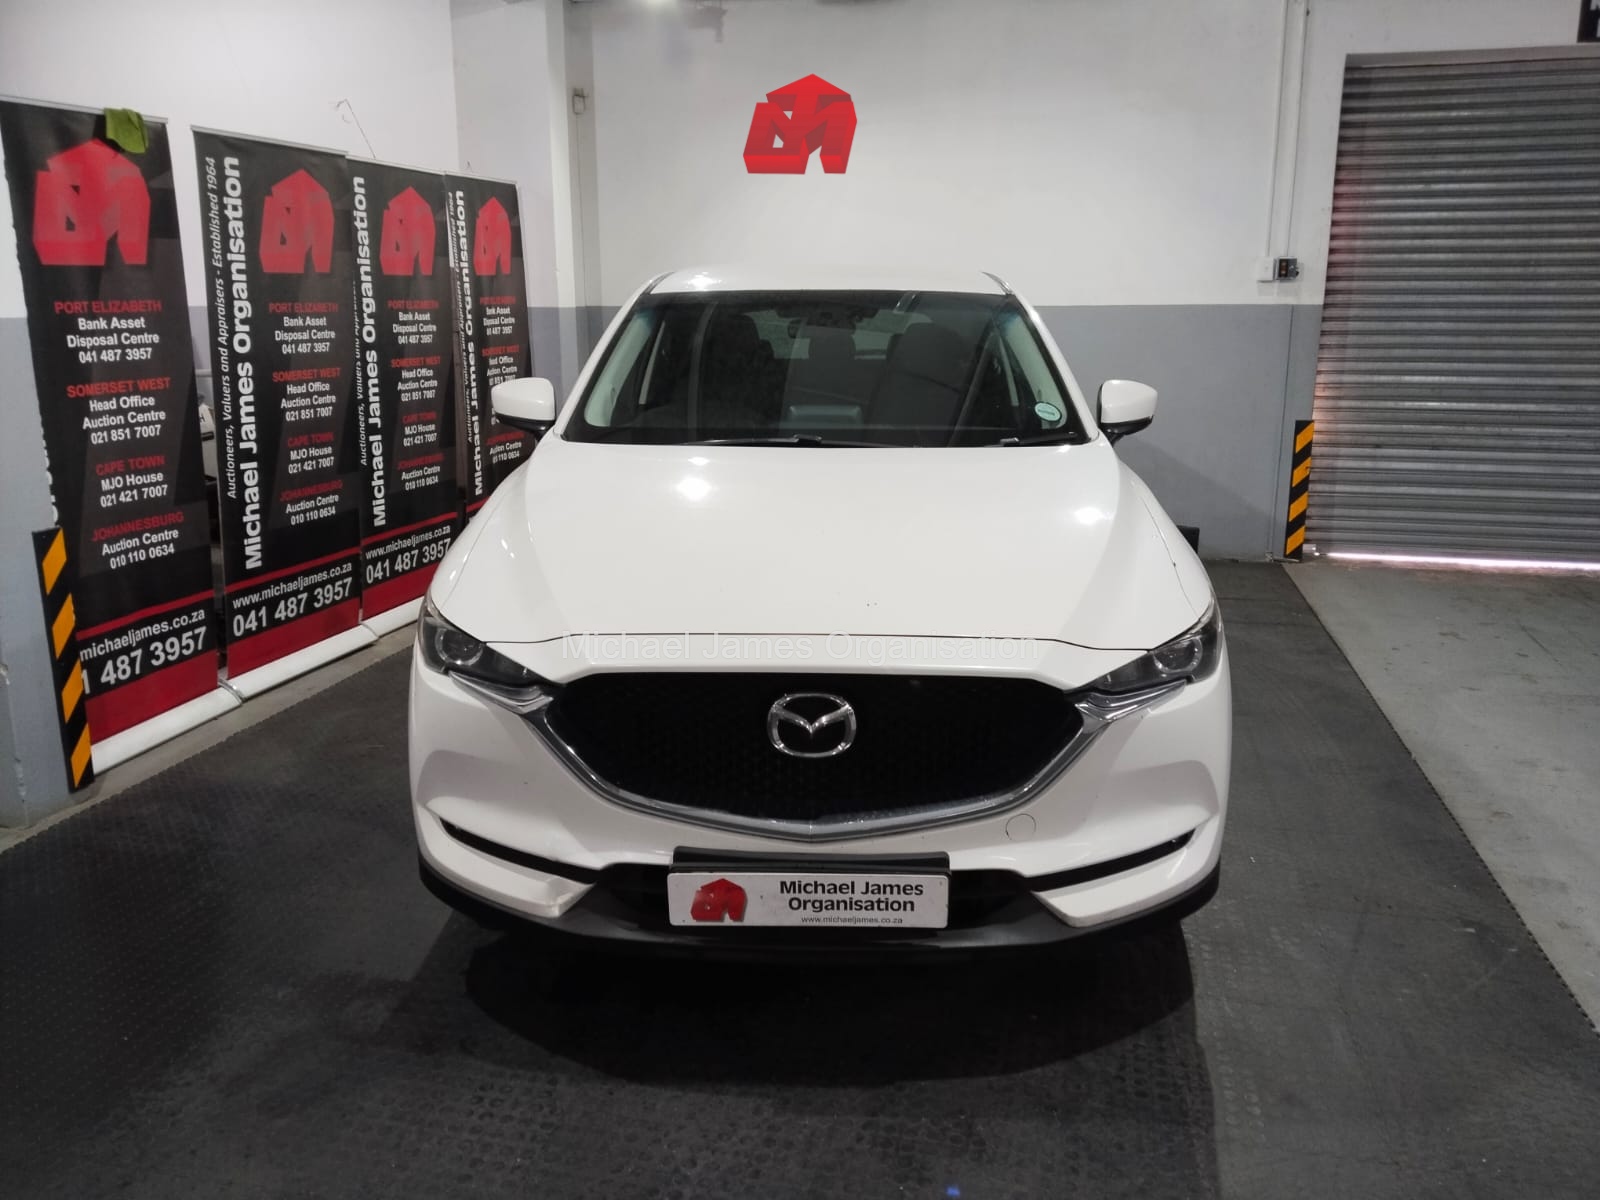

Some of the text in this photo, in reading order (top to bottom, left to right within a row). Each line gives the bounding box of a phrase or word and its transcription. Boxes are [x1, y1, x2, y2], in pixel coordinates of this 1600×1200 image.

[205, 156, 217, 190] 1964
[207, 193, 223, 268] Established
[353, 176, 376, 343] Organisation
[54, 300, 162, 314] PORT ELIZABETH
[212, 277, 228, 345] Appraisers
[78, 317, 146, 331] Bank Asset
[283, 316, 327, 327] Bank Asset
[66, 332, 160, 349] Disposal Centre
[274, 329, 336, 342] Disposal Centre
[456, 190, 483, 496] Michael James Organisation
[79, 347, 152, 364] 041 487 3957
[282, 342, 330, 354] 041 487 3957
[218, 347, 229, 373] and
[223, 156, 263, 570] Michael James Organisation
[66, 377, 171, 398] SOMERSET WEST
[287, 381, 330, 395] Head Office
[366, 350, 381, 428] James
[89, 395, 155, 412] Head Office
[220, 375, 232, 421] Valuers
[281, 394, 337, 409] Auction Centre
[82, 410, 166, 430] Auction Centre
[286, 406, 333, 421] 021 851 7007
[91, 424, 161, 445] 021 851 7007
[224, 424, 237, 499] Auctioneers,
[290, 446, 332, 461] MJO House
[96, 460, 125, 476] CAPE
[288, 463, 301, 474] 021
[303, 460, 316, 471] 421
[101, 472, 164, 491] MJO House
[369, 434, 386, 527] Michael
[100, 484, 168, 508] 021 421 7007
[285, 495, 339, 514] Auction Centre
[290, 506, 336, 526] 010 110 0634
[102, 529, 179, 556] Auction Centre
[366, 524, 451, 560] www.michaeljames.co.za
[110, 543, 175, 569] 010 110 0634
[366, 537, 451, 584] 041 487 3957
[232, 562, 352, 610] www.michaeljames.co.za
[233, 577, 353, 637] 041 487 3957
[100, 648, 142, 685] 487
[150, 626, 207, 666] 3957
[779, 881, 924, 897] Michael James
[788, 897, 915, 913] Organisation
[801, 915, 903, 925] www.michaeljames.co.za
